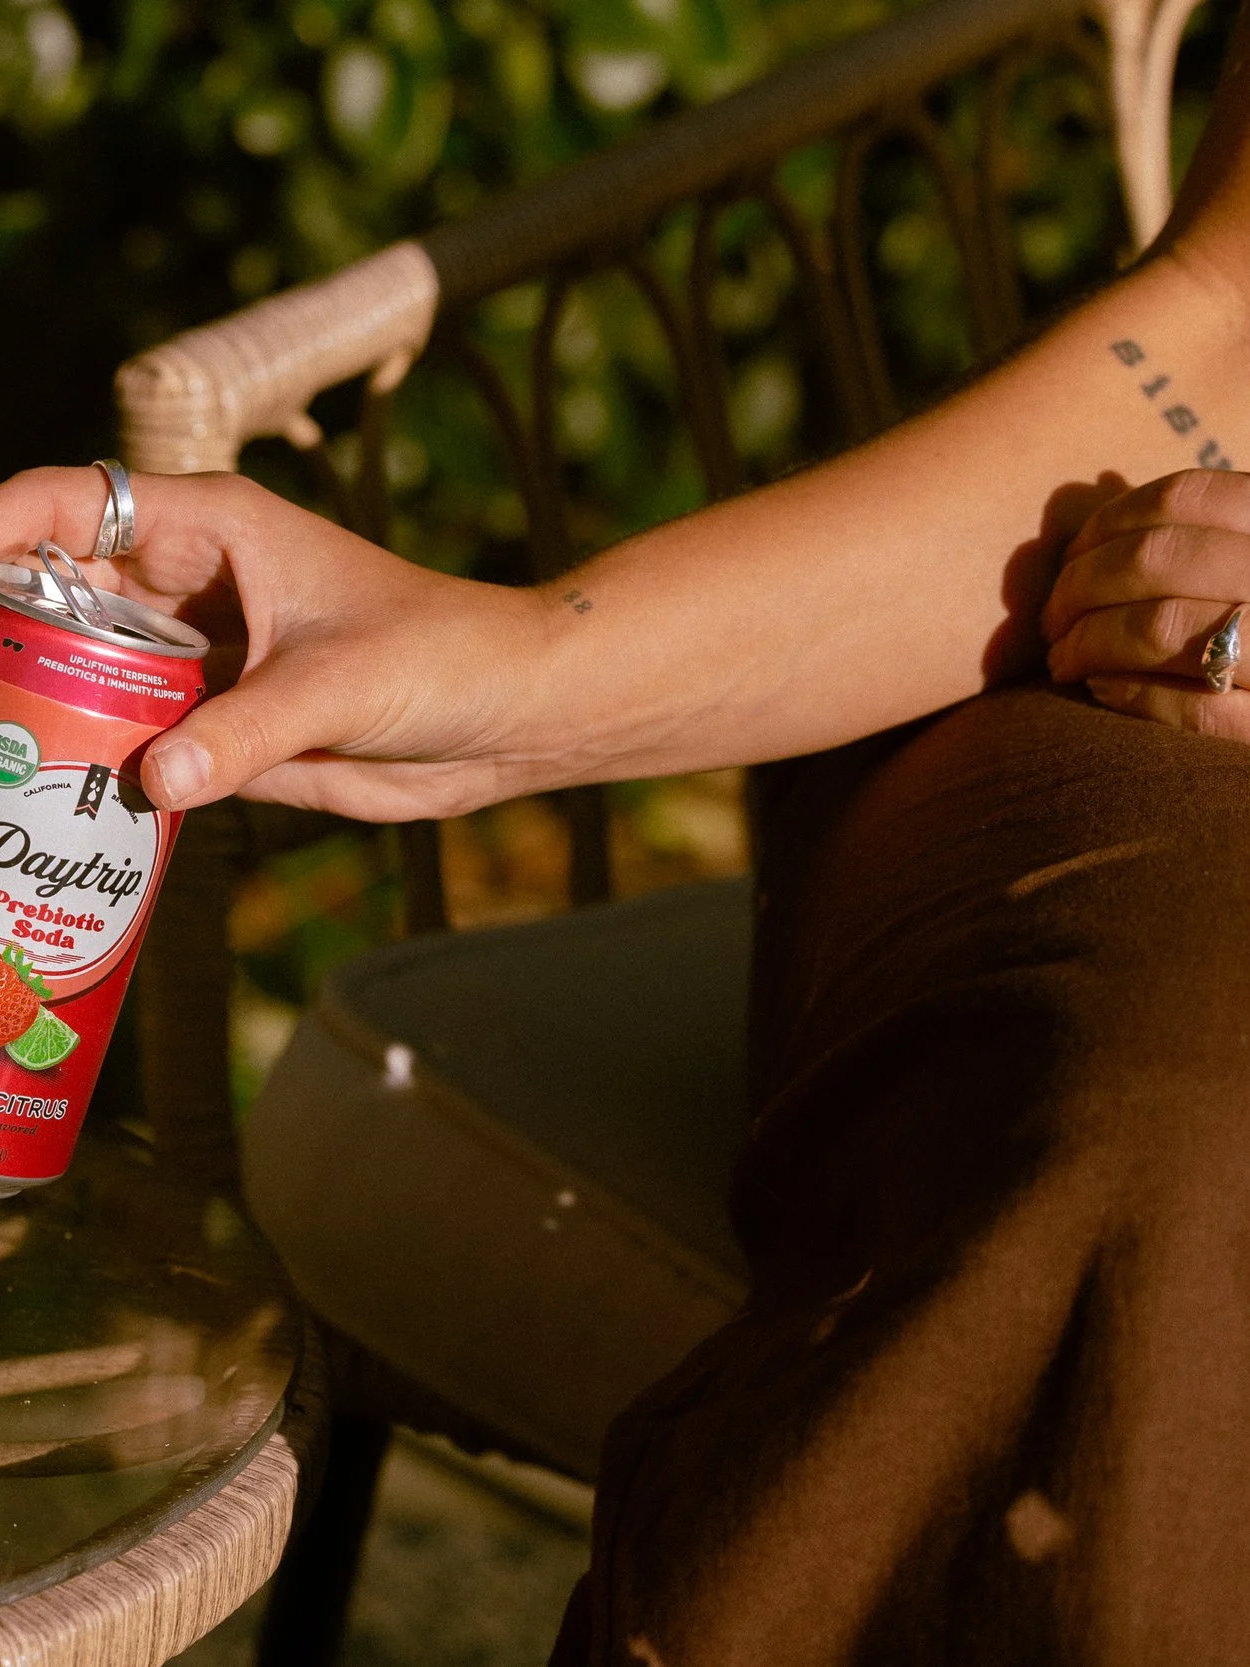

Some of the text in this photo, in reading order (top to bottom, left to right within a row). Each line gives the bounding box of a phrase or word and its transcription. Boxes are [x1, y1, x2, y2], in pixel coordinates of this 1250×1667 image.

[37, 656, 186, 702] PREBIOTICS & IMMUNITY SUPPORT
[69, 653, 120, 677] UPLIFTING
[120, 668, 164, 687] TERPENES
[23, 782, 72, 799] CALIFORNIA
[11, 918, 75, 950] Soda
